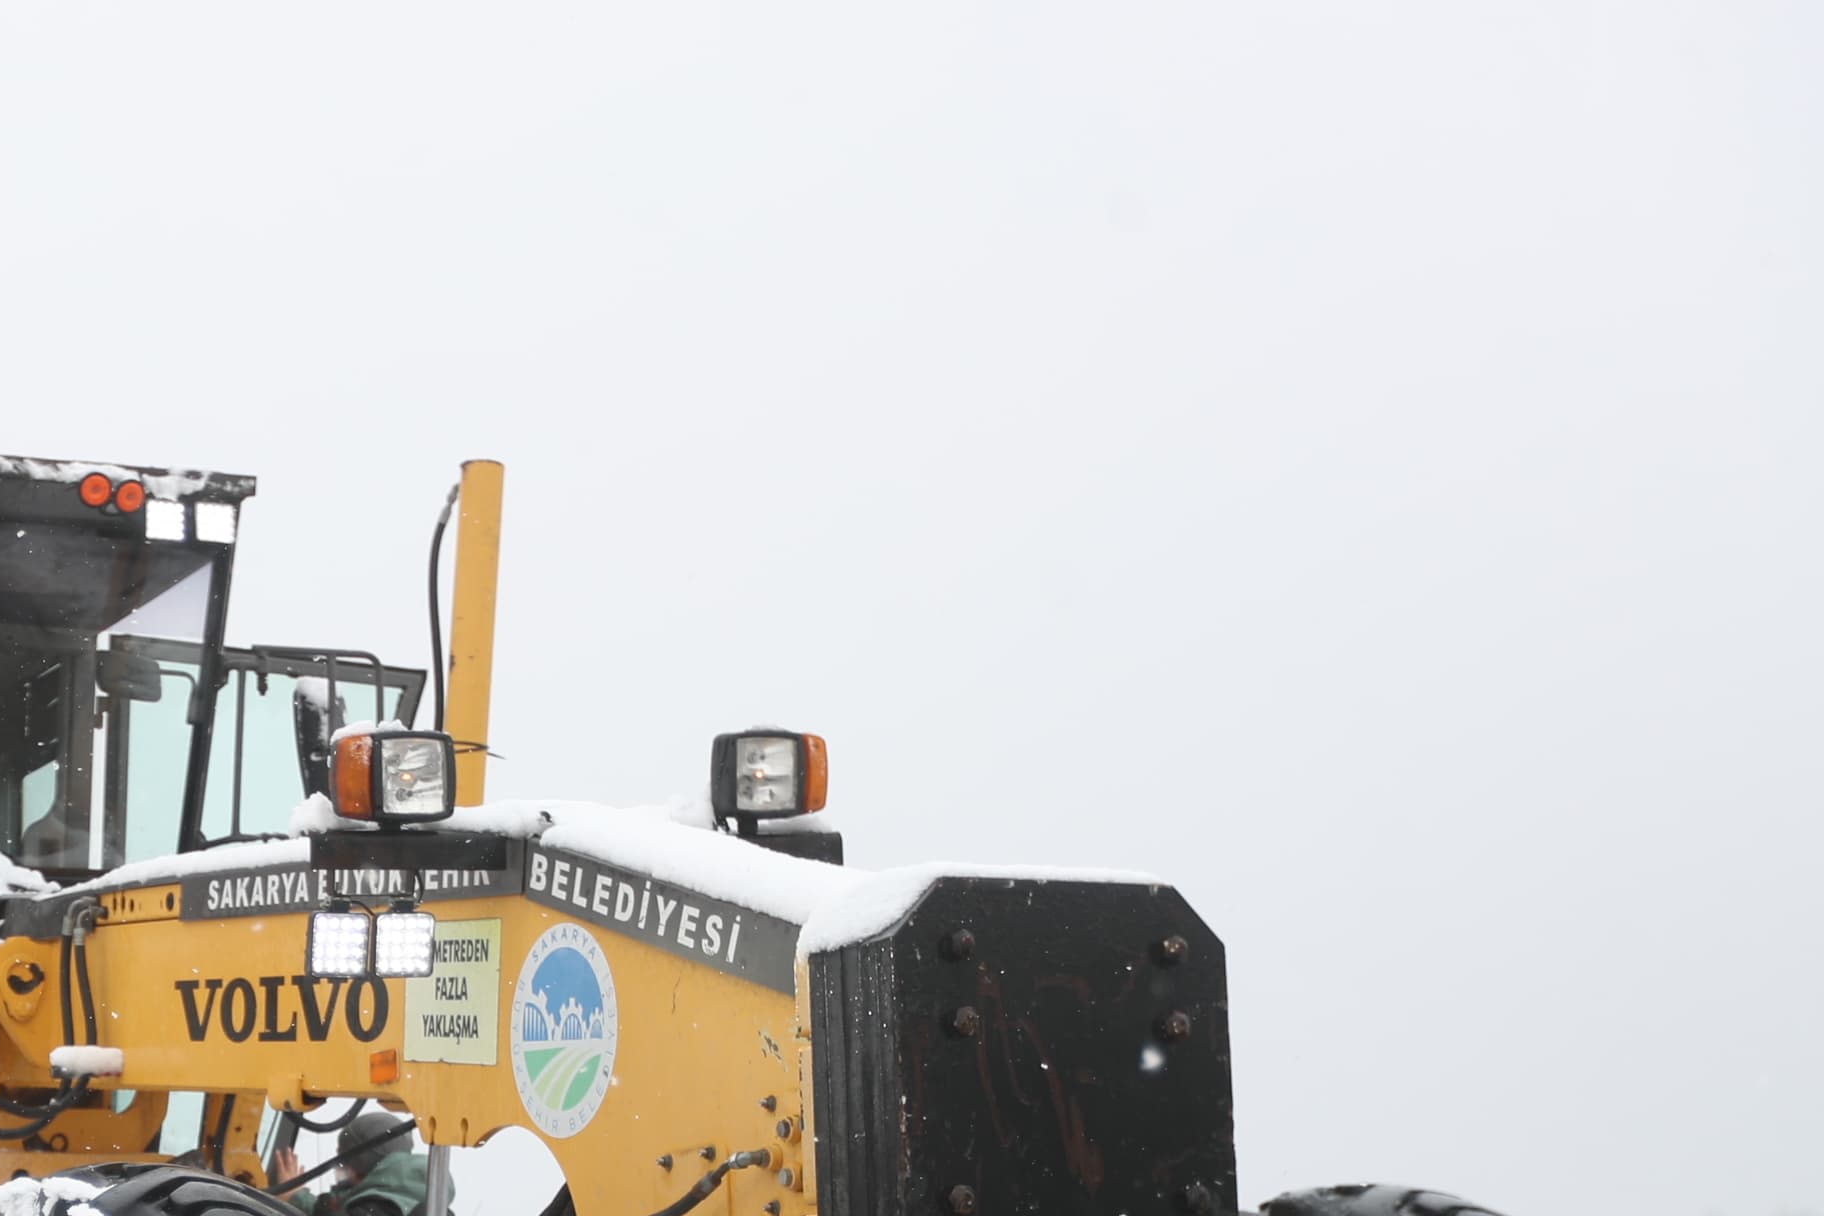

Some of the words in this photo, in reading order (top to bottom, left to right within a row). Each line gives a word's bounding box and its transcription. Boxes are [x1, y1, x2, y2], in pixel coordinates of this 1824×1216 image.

[207, 871, 310, 911] SAKARYA
[529, 852, 742, 964] BELEDİYESİ
[174, 975, 389, 1043] VOLVO
[435, 977, 468, 1000] FAZLA
[423, 1014, 479, 1045] YAKLAŞMA
